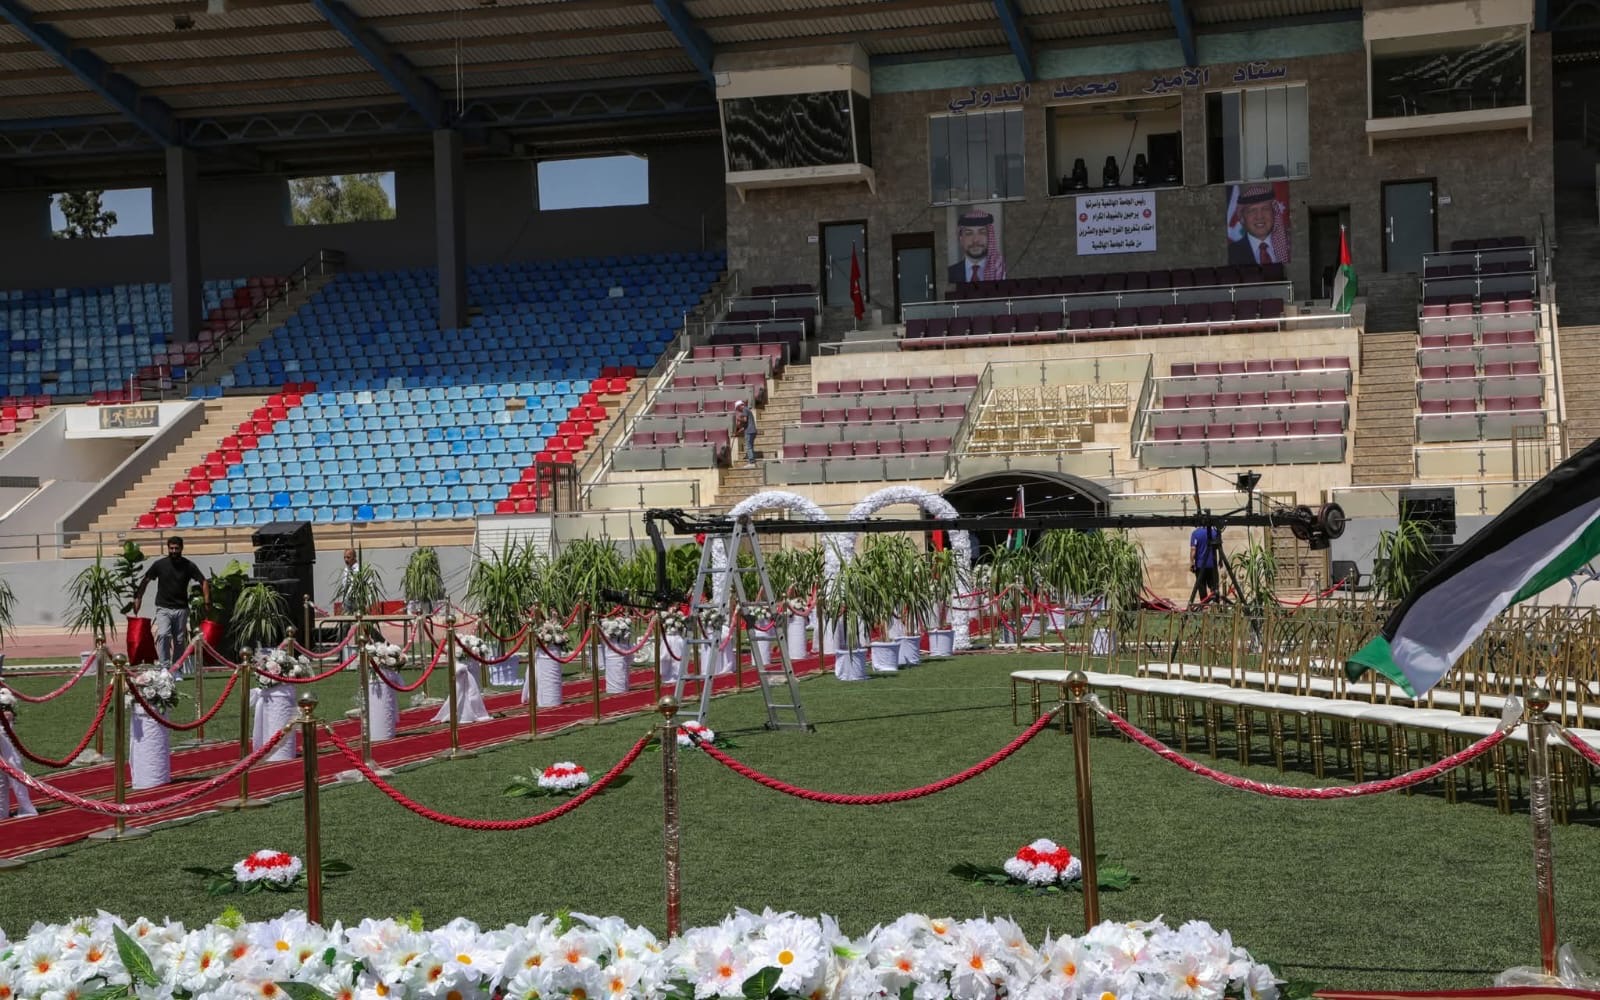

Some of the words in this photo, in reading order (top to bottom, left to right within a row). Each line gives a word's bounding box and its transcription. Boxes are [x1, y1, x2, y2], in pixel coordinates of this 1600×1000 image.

[1233, 61, 1286, 82] ستاد
[1053, 79, 1119, 99] محمد
[947, 84, 1030, 111] الدولي
[1101, 199, 1118, 208] الهاشمية
[1119, 197, 1134, 206] الجامعة
[126, 407, 156, 419] EXIT
